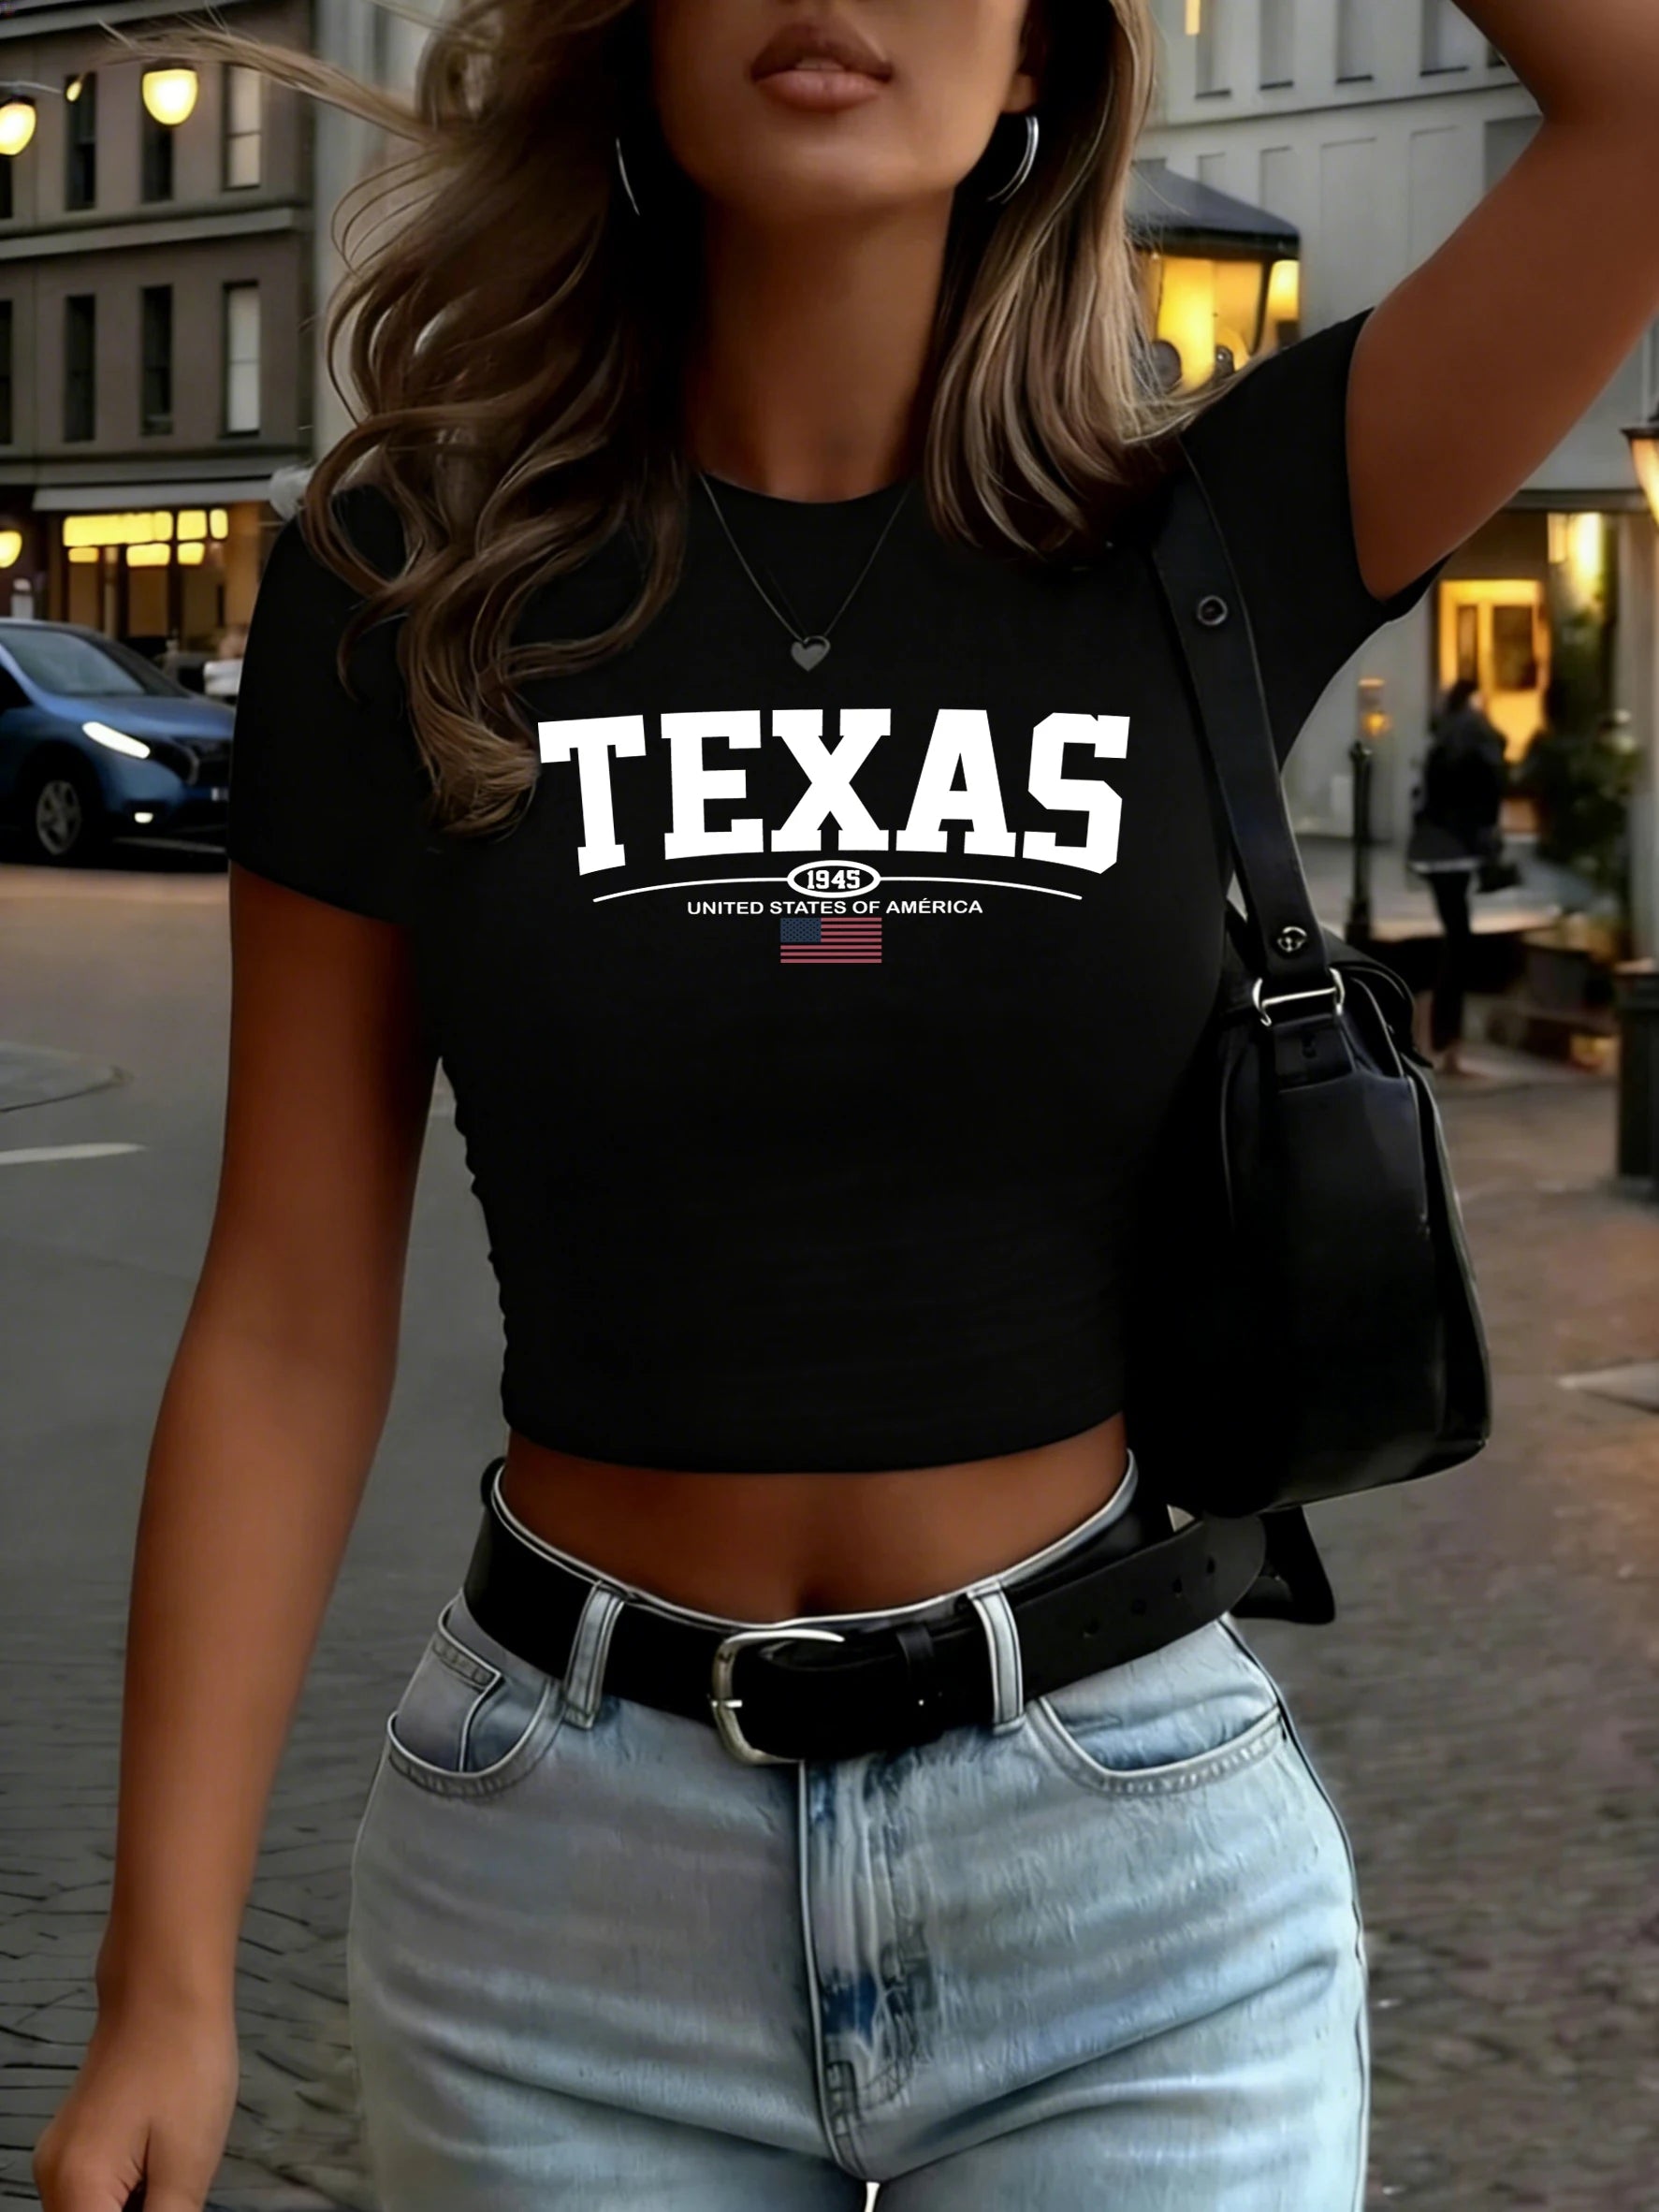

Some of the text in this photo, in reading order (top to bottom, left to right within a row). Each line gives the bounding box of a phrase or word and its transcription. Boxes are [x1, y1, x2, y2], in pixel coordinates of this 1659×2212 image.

[538, 708, 1130, 876] TEXAS
[807, 869, 861, 890] 1945
[688, 897, 983, 914] UNITED STATES OF AMÉRICA
